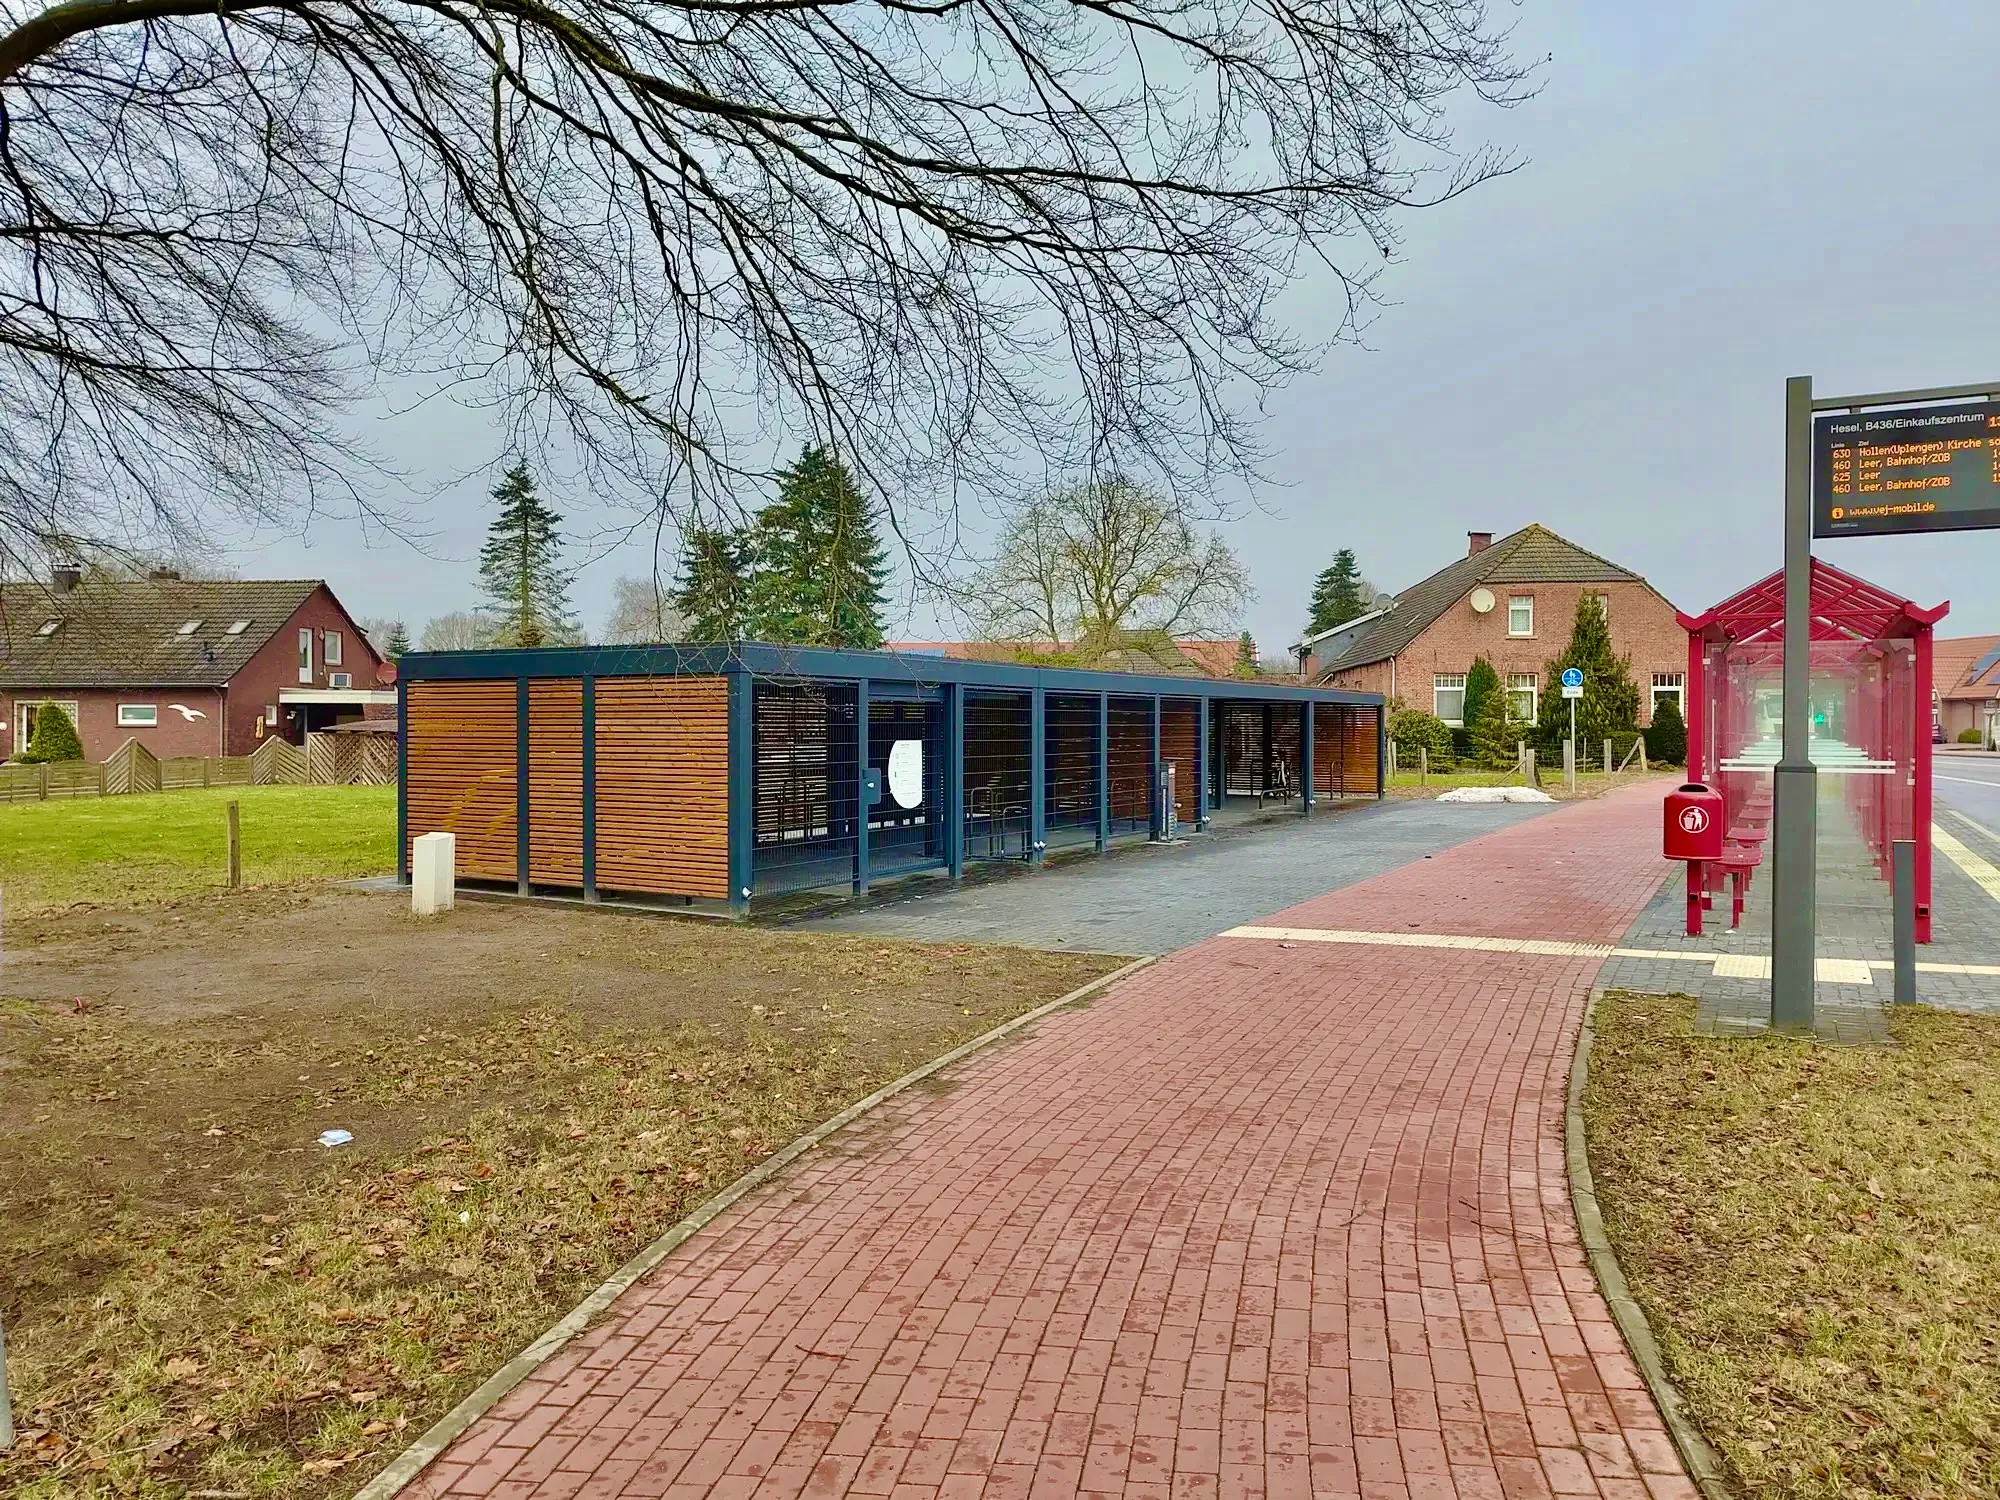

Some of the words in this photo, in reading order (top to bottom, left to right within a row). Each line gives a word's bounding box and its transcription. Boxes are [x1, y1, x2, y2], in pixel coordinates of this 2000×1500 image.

[1830, 422, 1863, 434] Hesel,
[1865, 413, 1985, 431] B436/Einkaufszentrum
[1833, 448, 1851, 459] 630
[1859, 441, 1944, 457] Hollen(Uplengen)
[1947, 438, 1982, 450] Kirche
[1832, 460, 1851, 470] 460
[1859, 459, 1883, 469] Leer,
[1886, 453, 1951, 467] Bahnhof/ZOB
[1832, 471, 1851, 482] 625
[1859, 471, 1881, 480] Leer
[1832, 483, 1851, 493] 460
[1859, 482, 1883, 492] Leer,
[1886, 476, 1951, 490] Bahnhof/ZOB
[1849, 502, 1936, 516] www.vej-mobil.de
